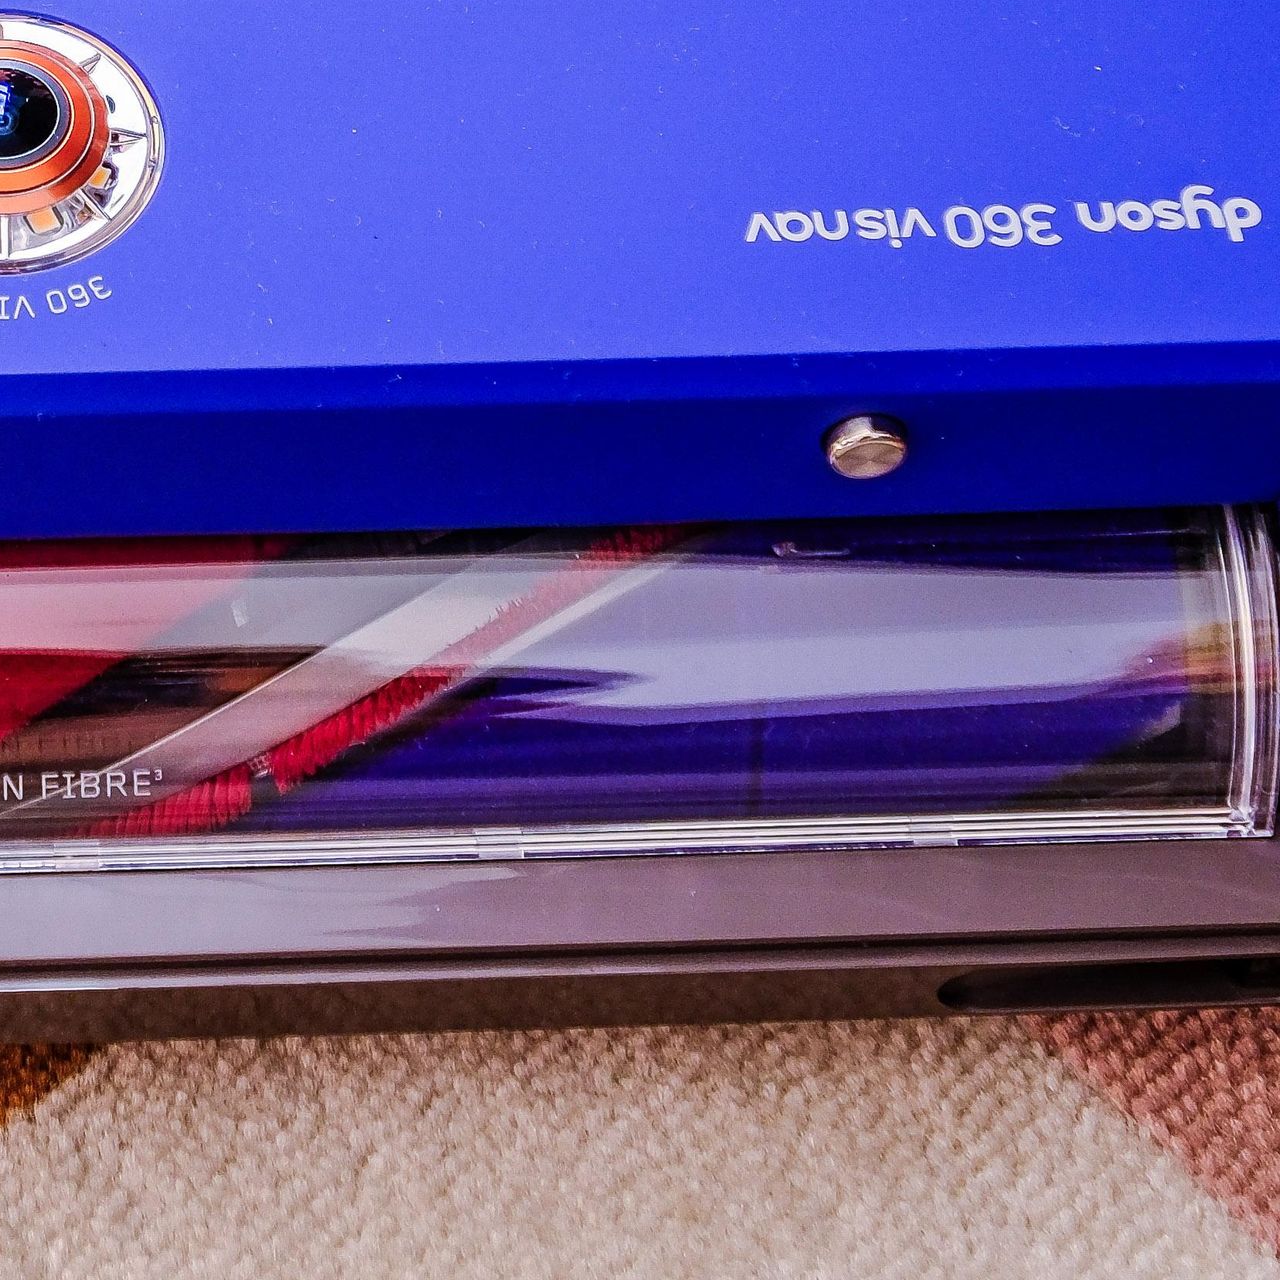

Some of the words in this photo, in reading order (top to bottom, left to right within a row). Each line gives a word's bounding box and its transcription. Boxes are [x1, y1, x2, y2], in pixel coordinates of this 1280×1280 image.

[943, 203, 1063, 248] 360
[1076, 184, 1263, 242] dyson
[45, 275, 113, 314] 360
